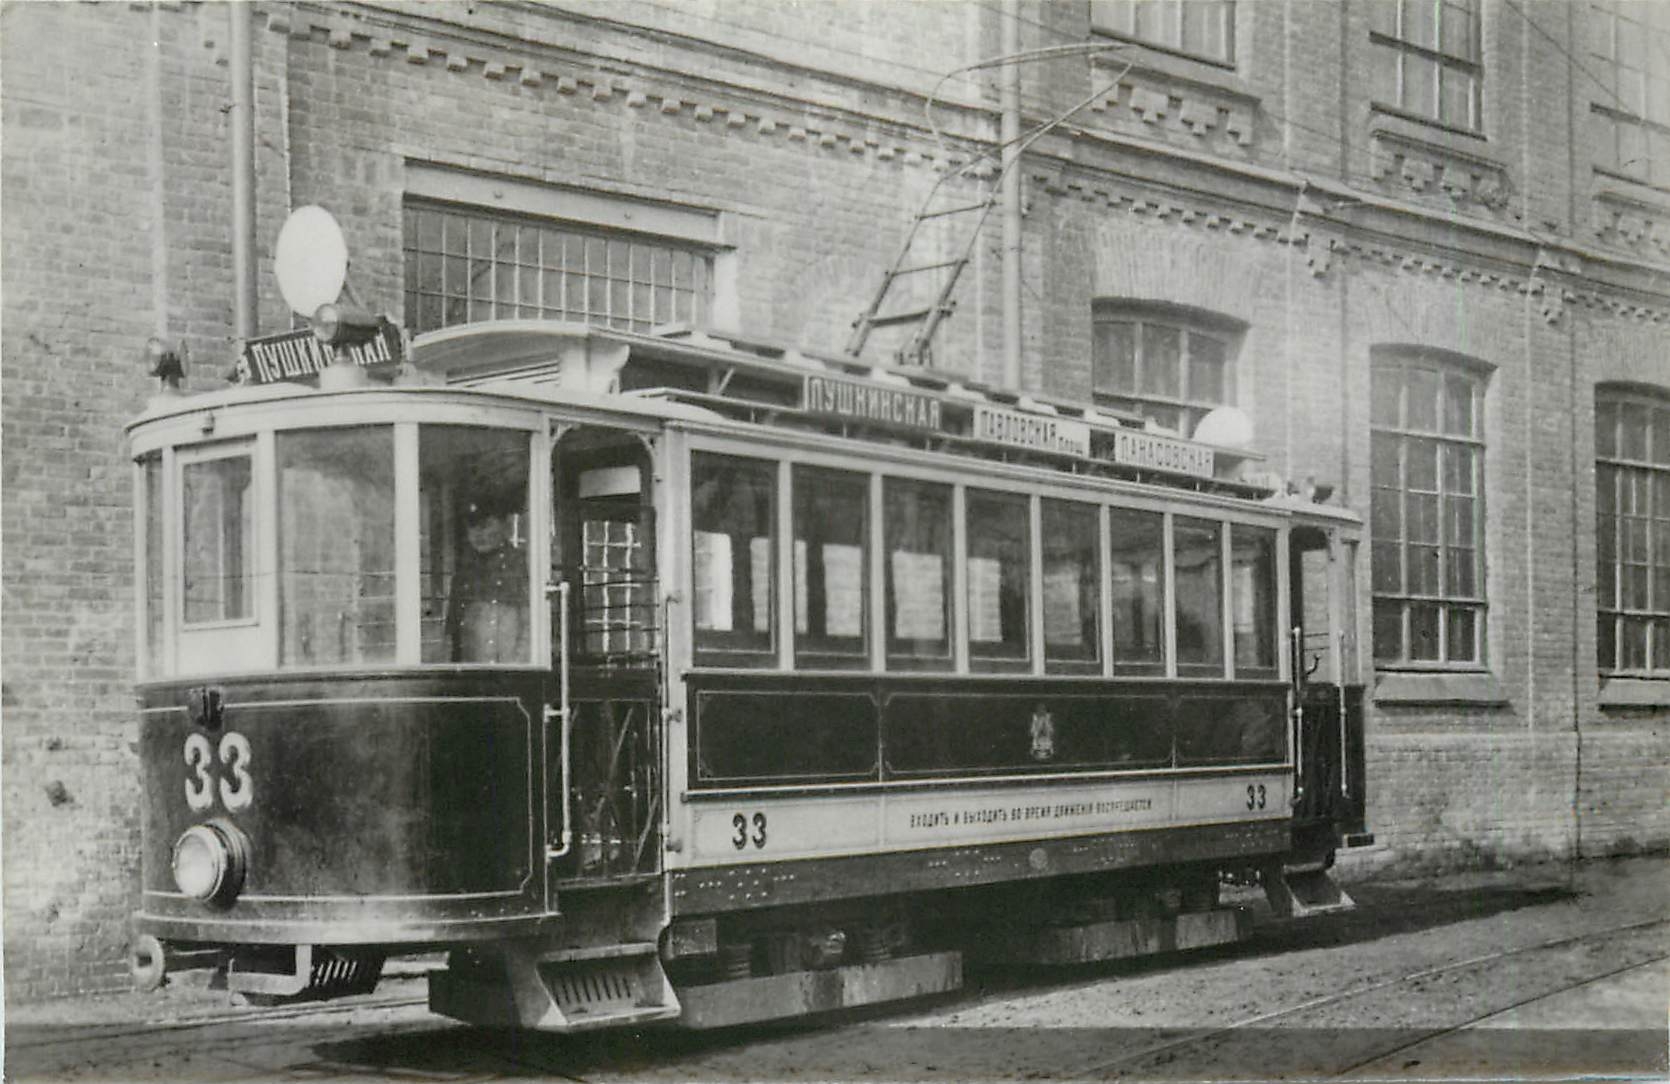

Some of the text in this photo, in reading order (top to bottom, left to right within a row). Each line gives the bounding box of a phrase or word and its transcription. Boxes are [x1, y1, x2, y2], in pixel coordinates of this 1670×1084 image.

[251, 332, 392, 383] ПУШКИНАЯ
[810, 378, 940, 430] ПУШКИНСКАЯ
[981, 409, 1057, 450] ПАВЛОВСКАЯ
[1120, 435, 1212, 476] ПАНАСОВСКАЯ
[183, 732, 253, 813] 33
[910, 812, 949, 828] ВХОДИТЬ
[953, 812, 959, 825] И
[963, 808, 1007, 825] ВЫХОДИТЬ
[1011, 807, 1022, 821] ВО
[1025, 804, 1051, 820] ВРЕМЯ
[1247, 784, 1266, 811] 33
[732, 812, 767, 850] 33
